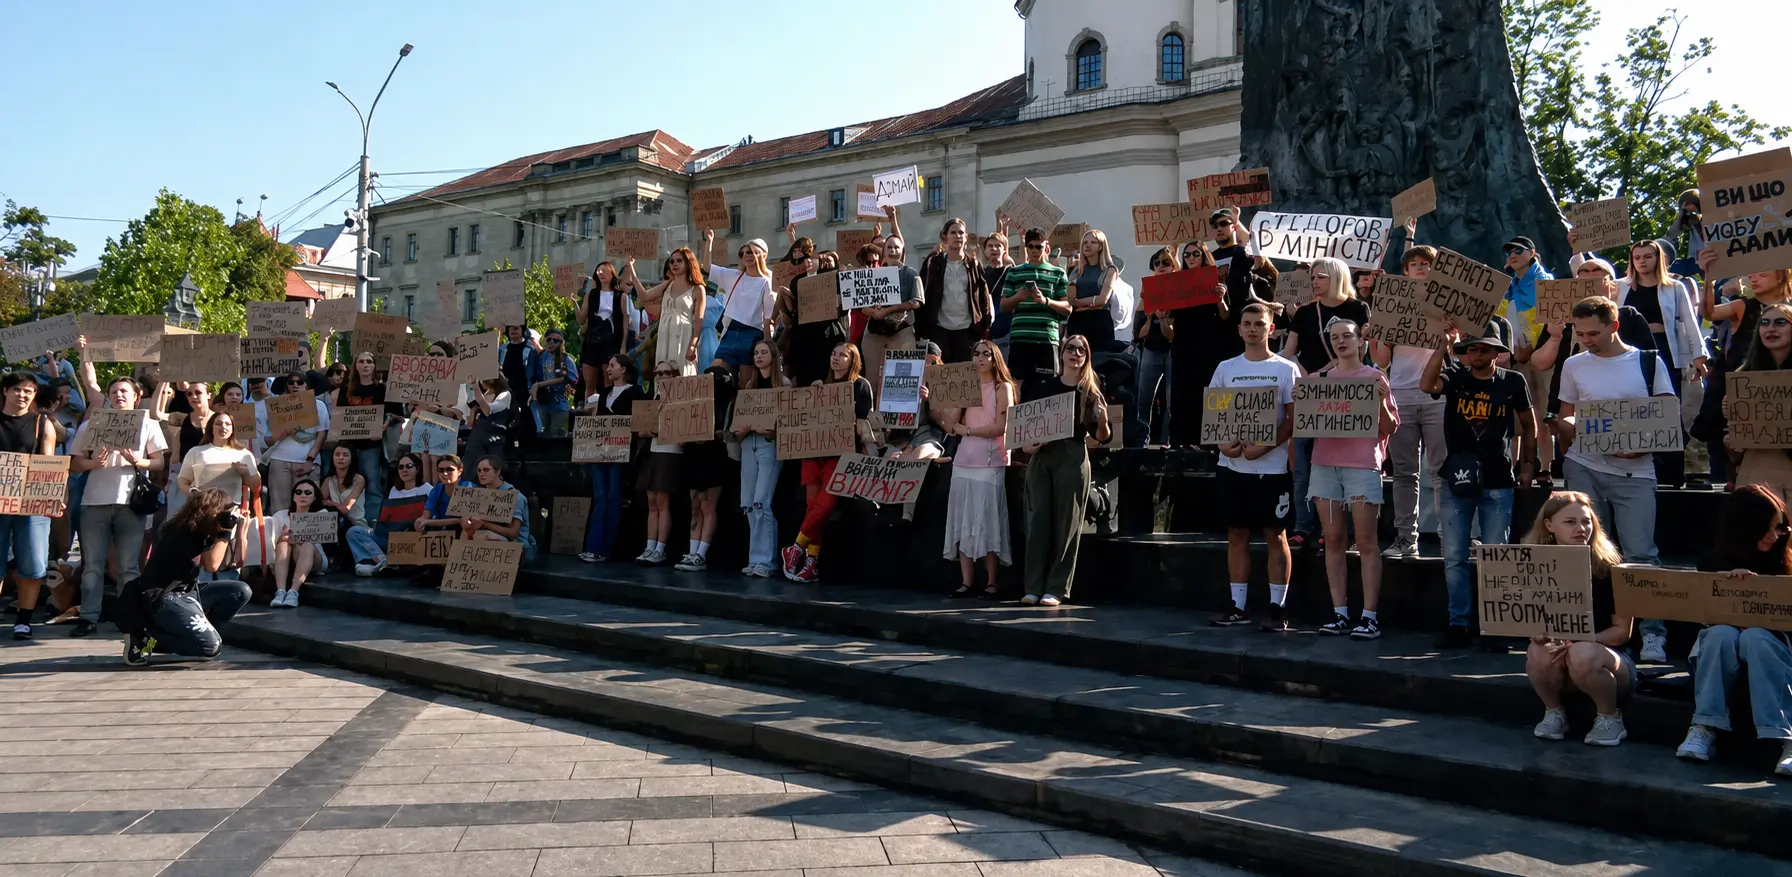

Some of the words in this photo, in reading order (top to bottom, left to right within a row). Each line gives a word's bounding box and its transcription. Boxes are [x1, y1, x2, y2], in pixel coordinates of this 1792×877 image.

[1714, 186, 1745, 207] ВИ
[1234, 411, 1260, 423] МАЄ
[1296, 414, 1373, 431] ЗАГИНЕМО
[1585, 418, 1613, 434] НЕ
